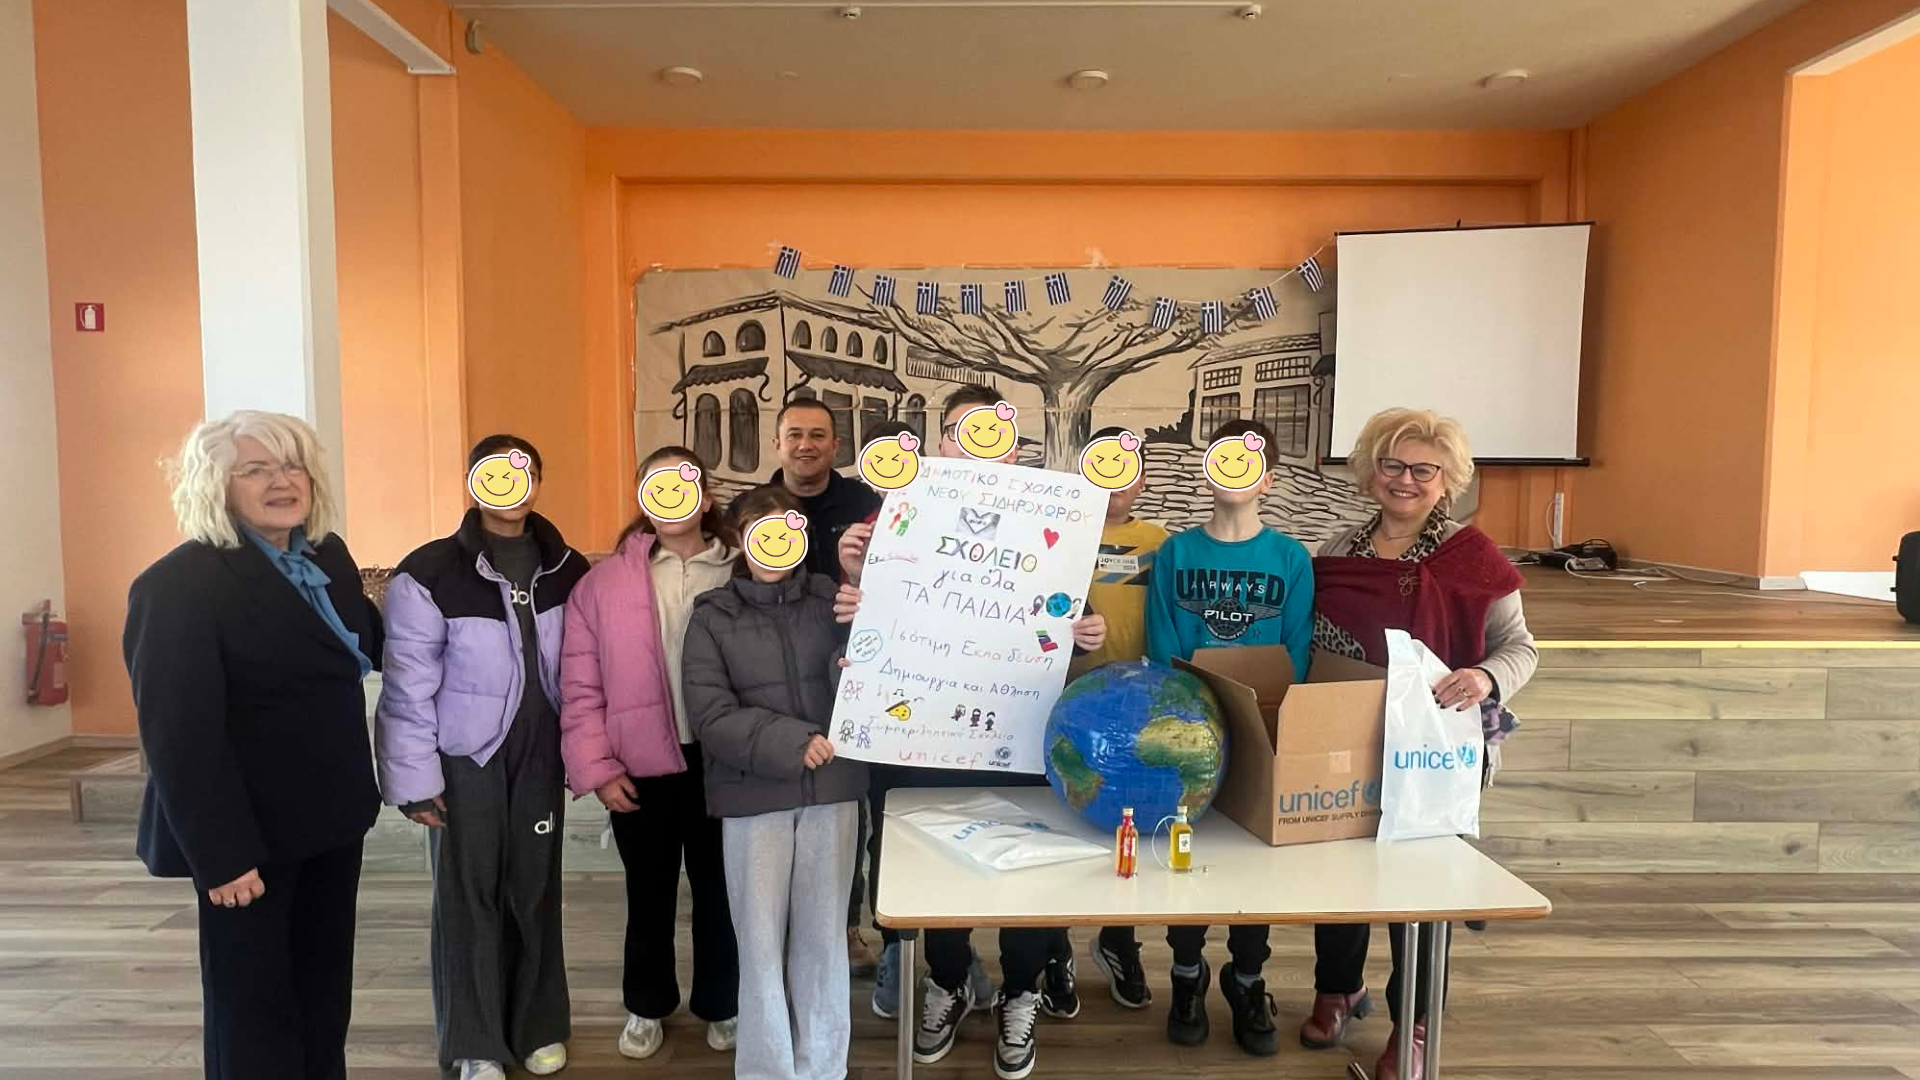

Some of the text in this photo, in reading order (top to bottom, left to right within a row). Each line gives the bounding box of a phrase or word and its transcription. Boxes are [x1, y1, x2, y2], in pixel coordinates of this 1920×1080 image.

[920, 465, 1080, 499] ΔΗΜΟΤΙΚΟ ΣΧΟΛΕΙΟ
[927, 486, 970, 502] ΝΕΟΥ
[935, 536, 1038, 573] ΣΧΟΛΕΙΟ
[1175, 568, 1286, 606] UNITED
[1191, 580, 1266, 594] AIRWAYS
[901, 580, 1027, 626] ΤΑ ΠΑΙΔΙΑ
[1203, 609, 1254, 623] PILOT
[899, 749, 983, 769] unicef
[1394, 743, 1455, 770] unice
[1279, 780, 1360, 813] unicef
[1278, 817, 1301, 826] FROM
[1302, 814, 1330, 824] UNICEF
